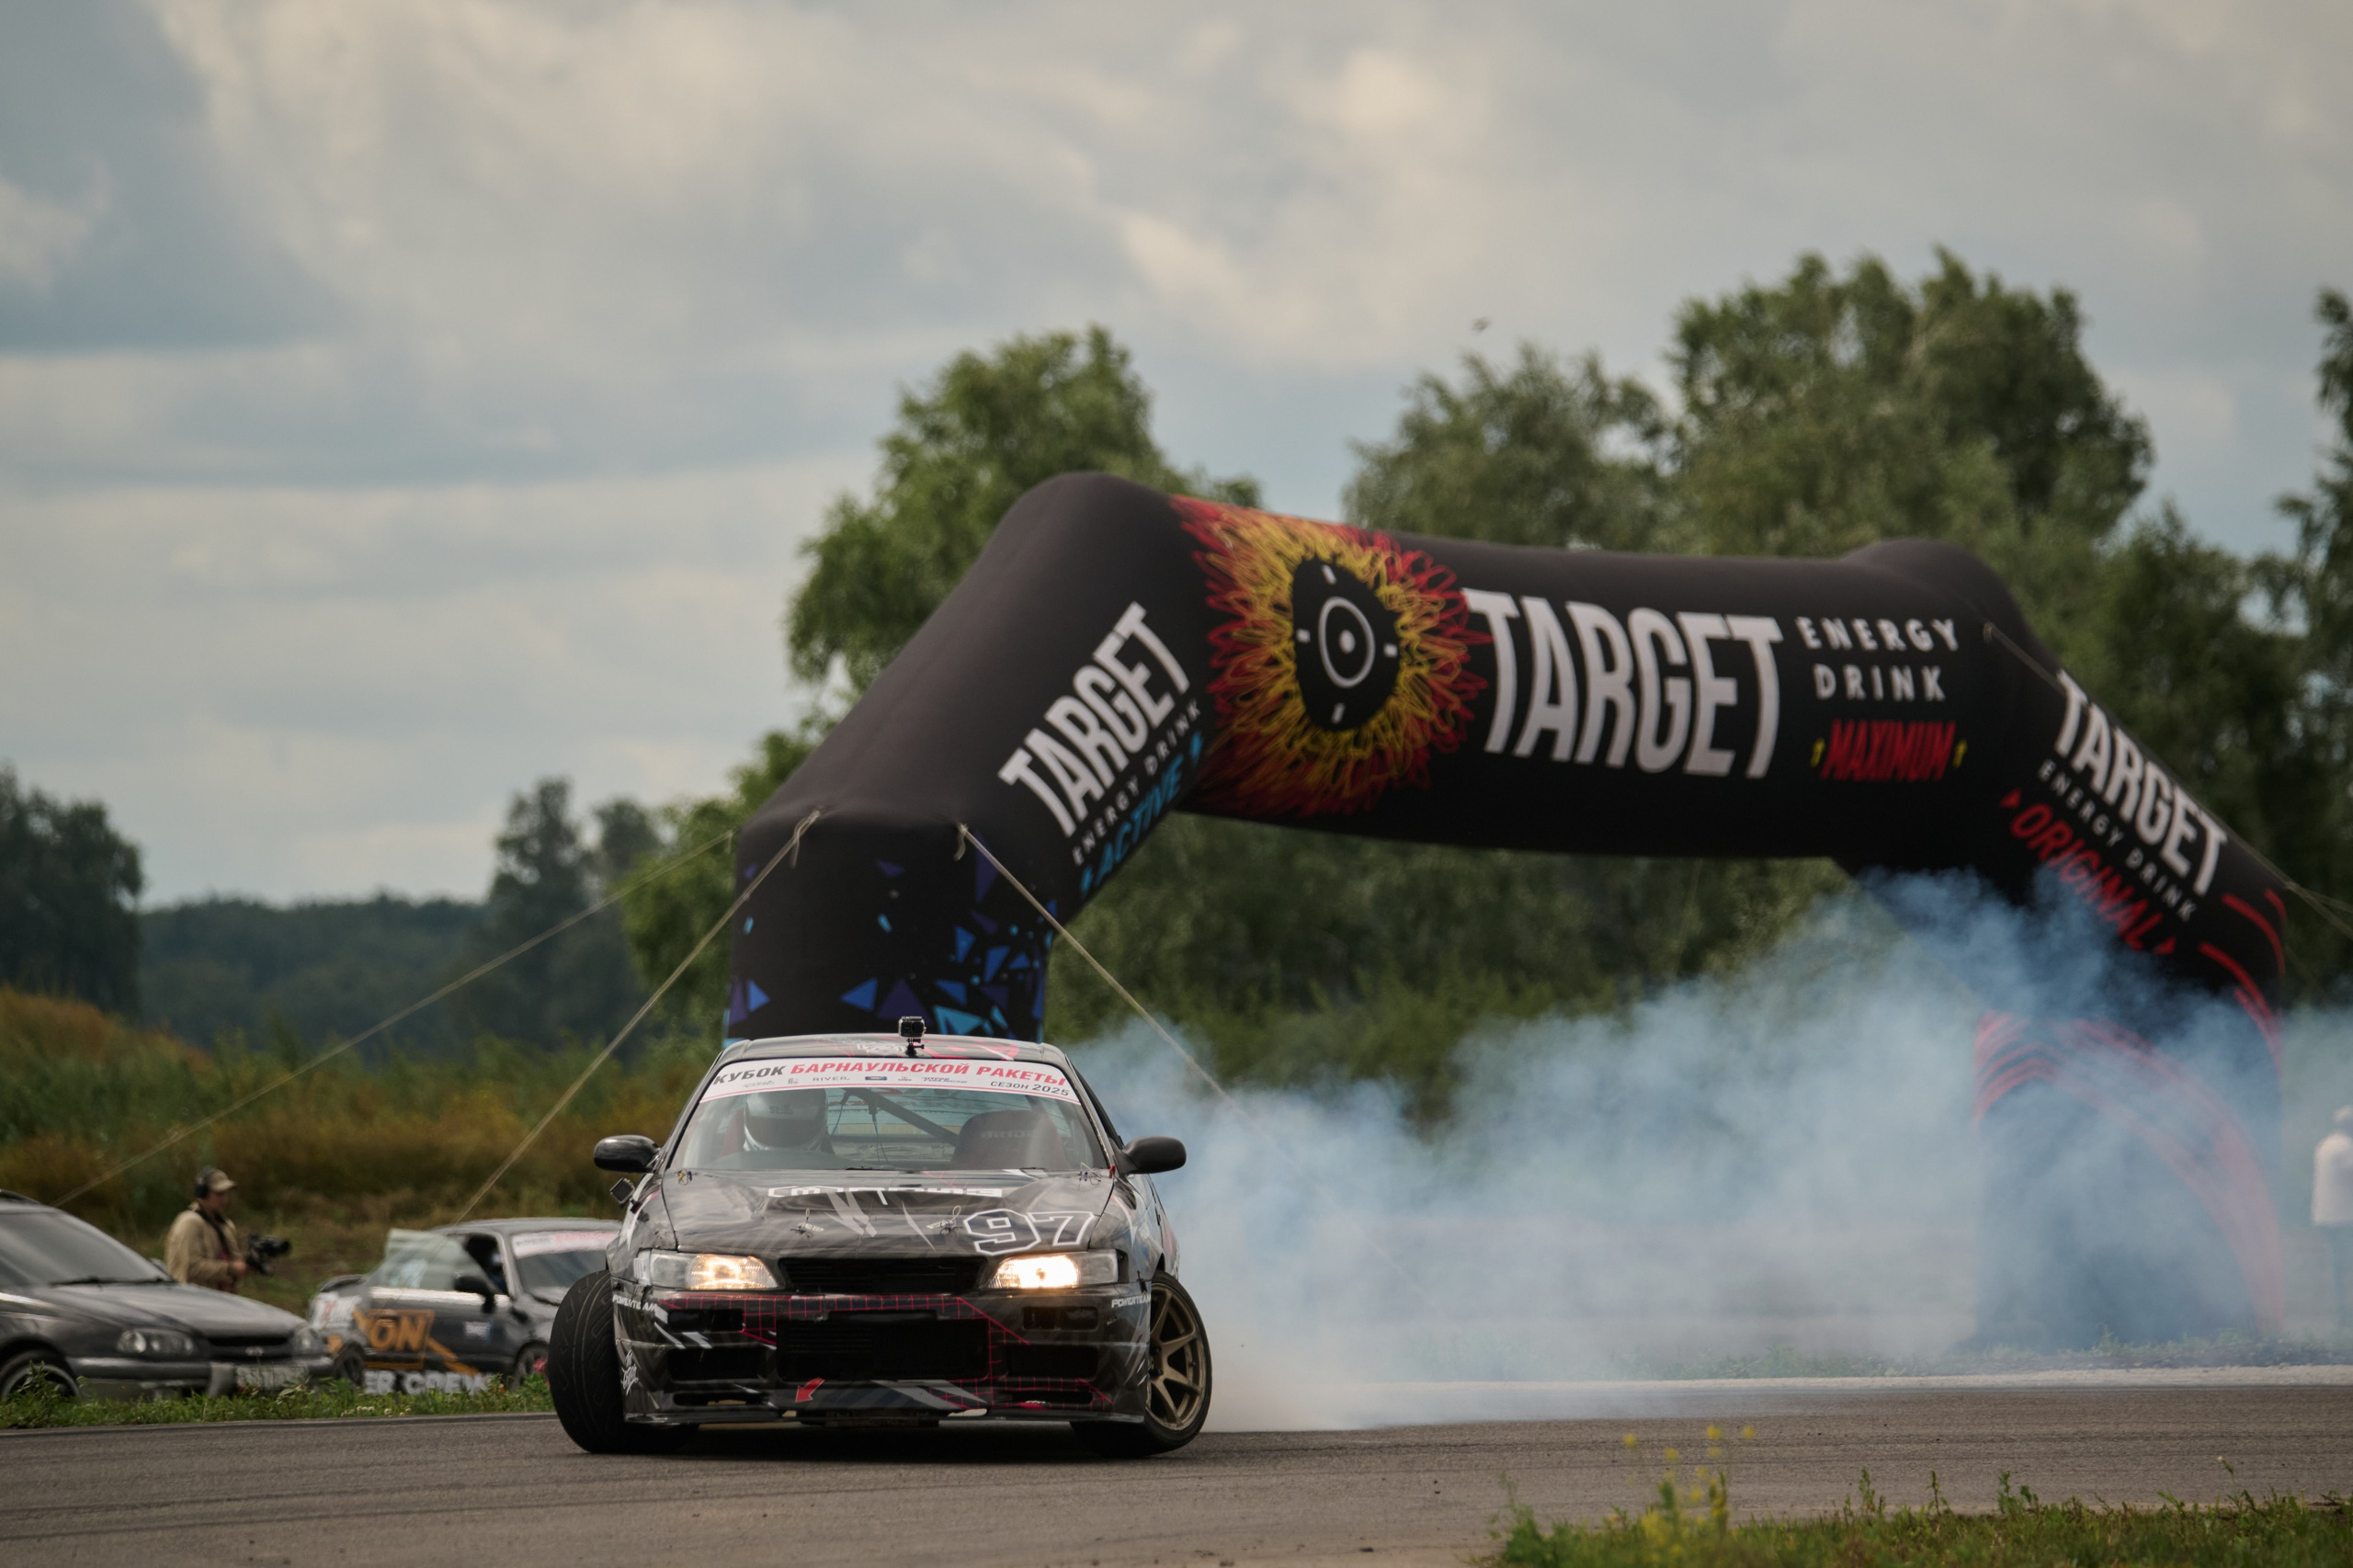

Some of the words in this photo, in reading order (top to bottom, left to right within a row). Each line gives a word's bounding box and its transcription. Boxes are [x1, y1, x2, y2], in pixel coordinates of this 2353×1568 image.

[1794, 616, 1959, 652] ENERGY
[1461, 587, 1784, 779] TARGET
[1812, 663, 1946, 702] DRINK
[998, 600, 1190, 838] TARGET
[1819, 718, 1956, 782] MAXIMUM
[1072, 775, 1140, 866] ENERGY
[1144, 699, 1200, 776] DRINK
[2053, 668, 2228, 897] TARGET
[2036, 758, 2125, 848] ENERGY
[2124, 847, 2198, 923] DRINK
[712, 1064, 787, 1085] КУБОК
[790, 1062, 971, 1075] БАРНАУЛЬСКОЙ
[975, 1065, 1066, 1086] РАКЕТЫ
[990, 1080, 1029, 1090] СЕЗОН
[1031, 1084, 1071, 1096] 2025
[963, 1208, 1097, 1256] 97
